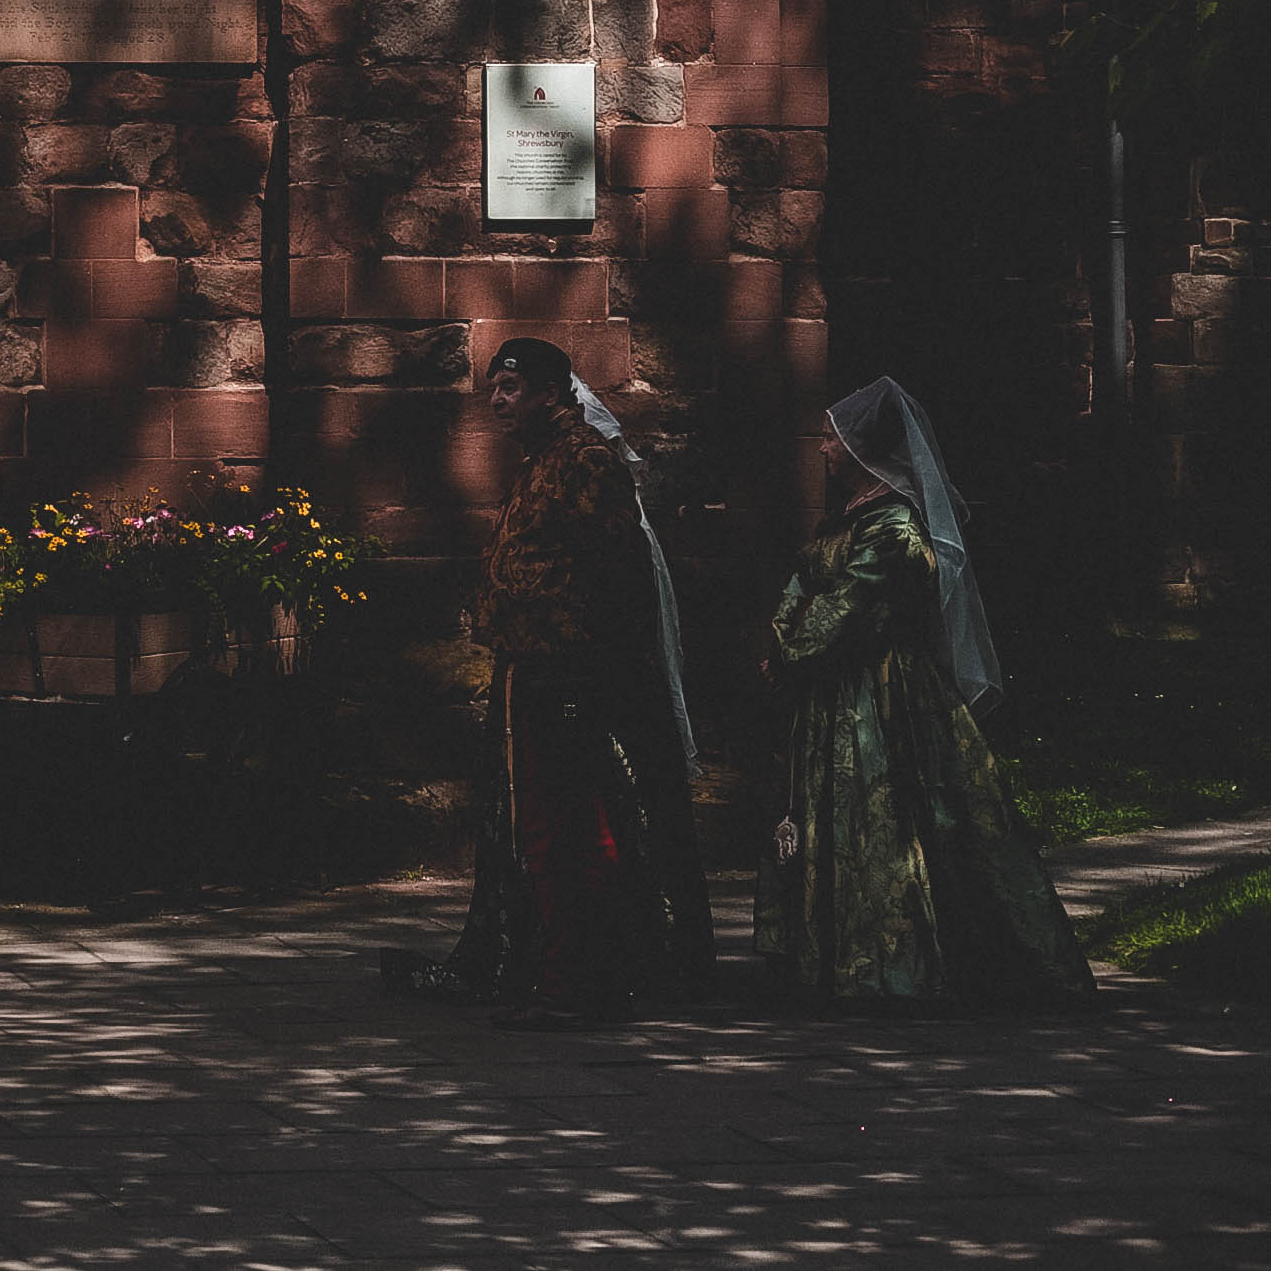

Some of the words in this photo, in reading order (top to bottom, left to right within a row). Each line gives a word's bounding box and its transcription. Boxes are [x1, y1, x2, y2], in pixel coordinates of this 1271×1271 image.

[507, 130, 515, 138] St
[517, 130, 535, 139] Mary
[536, 130, 549, 138] the
[551, 130, 574, 139] Virgin,
[518, 140, 563, 148] Shrewsbury
